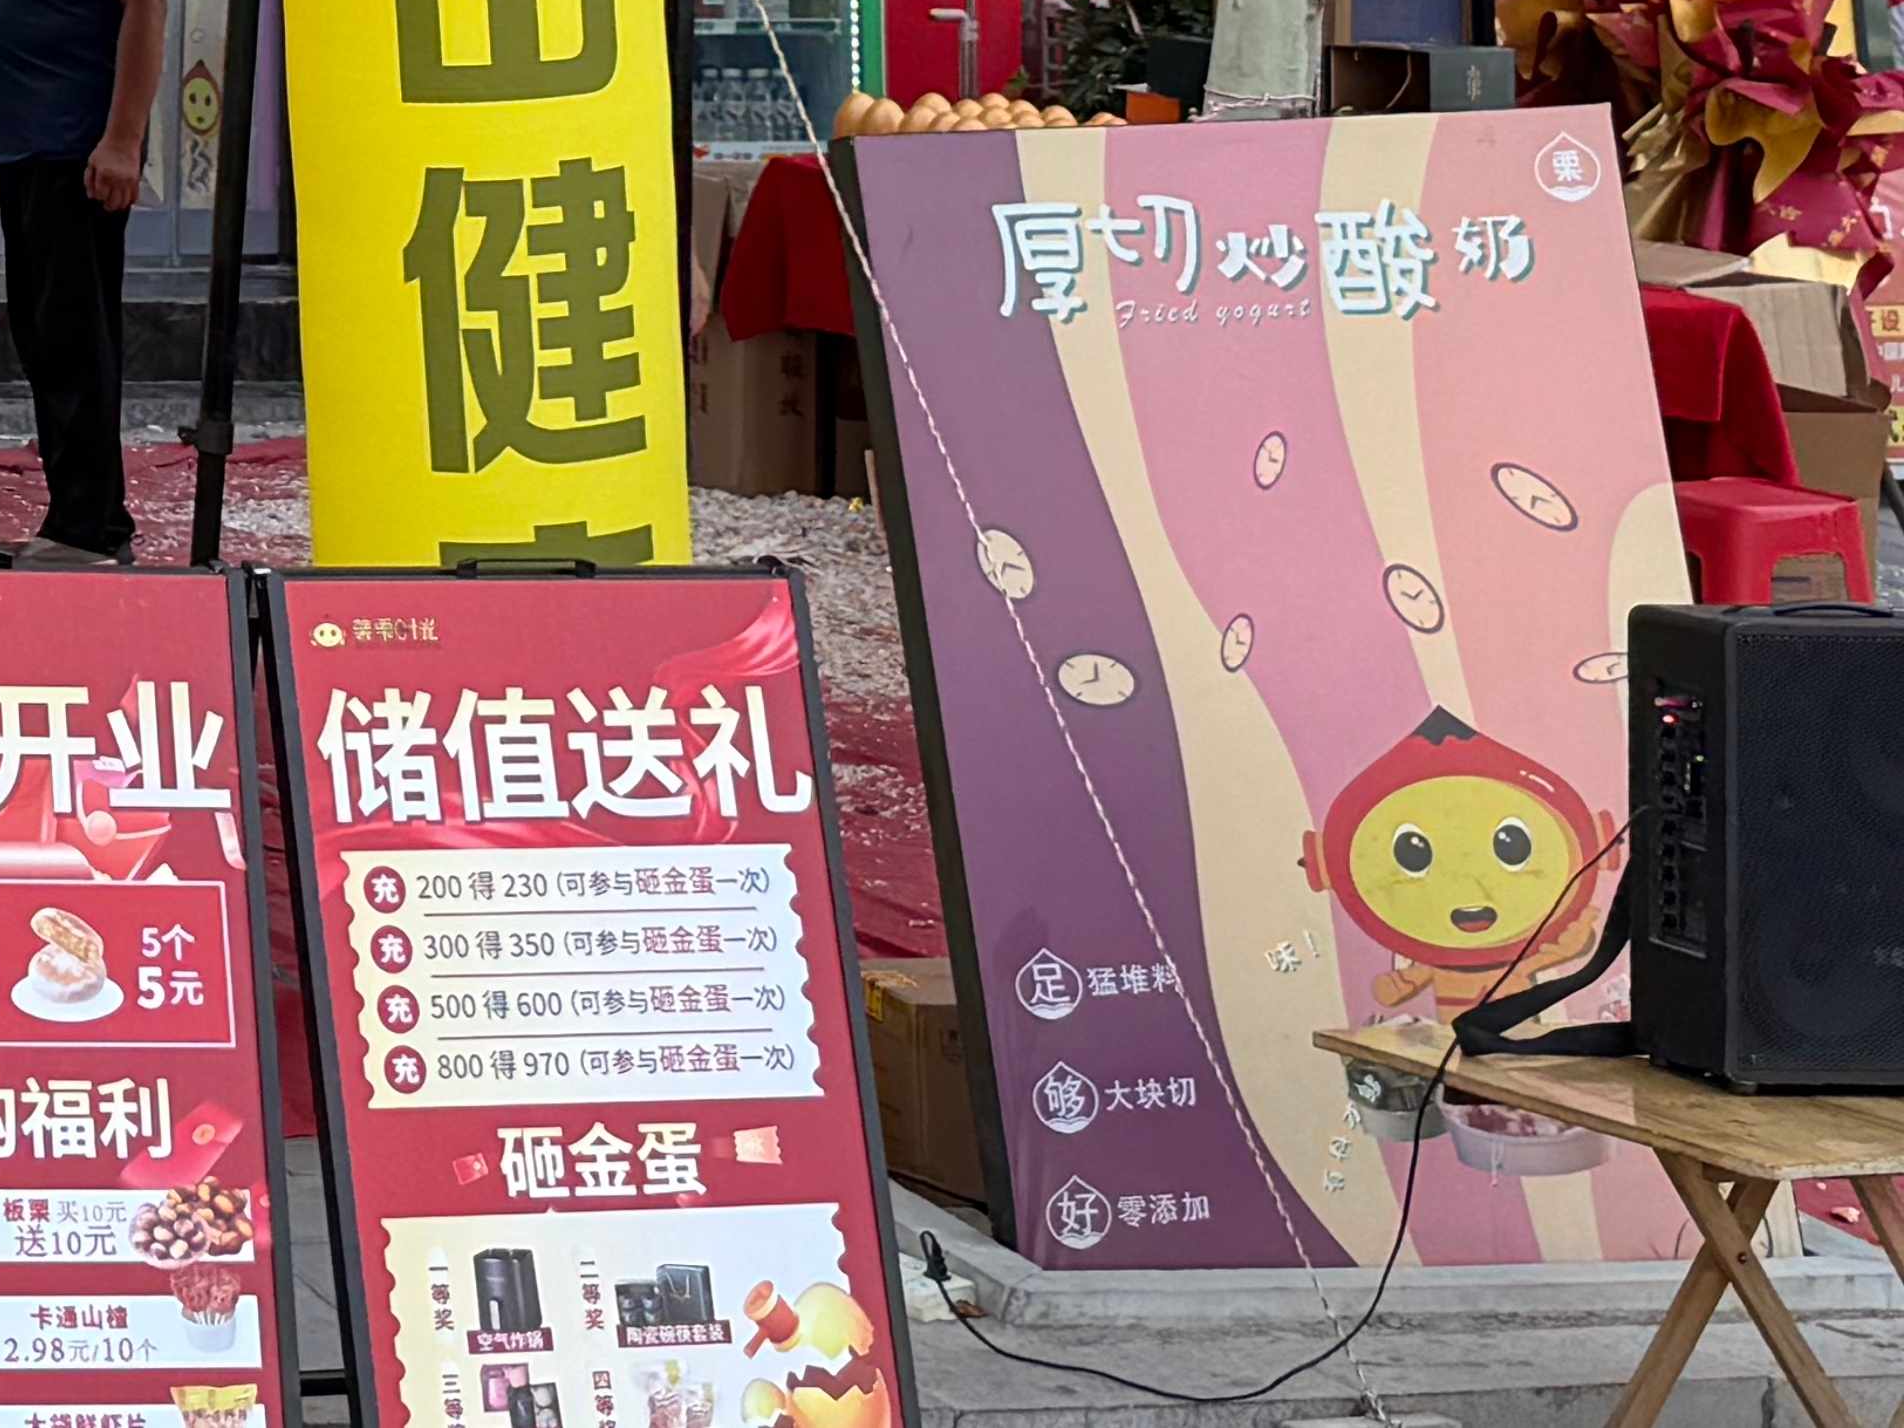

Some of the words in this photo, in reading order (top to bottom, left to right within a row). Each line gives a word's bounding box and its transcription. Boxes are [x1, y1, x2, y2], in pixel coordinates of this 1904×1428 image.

[992, 194, 1536, 324] 厚切炒酸奶
[1113, 299, 1201, 330] Fried
[1215, 296, 1313, 331] yogurt
[316, 684, 813, 828] 储值送礼
[370, 875, 401, 905] 充
[415, 874, 463, 900] 200
[469, 873, 495, 901] 得
[503, 874, 548, 899] 230
[140, 923, 196, 961] 5个
[377, 935, 407, 964] 充
[423, 933, 470, 960] 300
[476, 932, 503, 960] 得
[509, 932, 555, 957] 350
[135, 965, 205, 1011] 5元
[1029, 962, 1071, 1004] 足
[384, 995, 414, 1025] 充
[430, 993, 477, 1020] 500
[482, 991, 511, 1020] 得
[516, 992, 563, 1018] 600
[391, 1057, 422, 1086] 充
[437, 1053, 484, 1080] 800
[490, 1052, 518, 1080] 得
[524, 1051, 570, 1078] 970
[1043, 1075, 1086, 1118] 够
[1103, 1076, 1197, 1112] 大块切
[497, 1122, 708, 1200] 砸金蛋
[1057, 1190, 1099, 1236] 好
[1116, 1191, 1211, 1228] 零添加
[14, 1224, 118, 1258] 送10元
